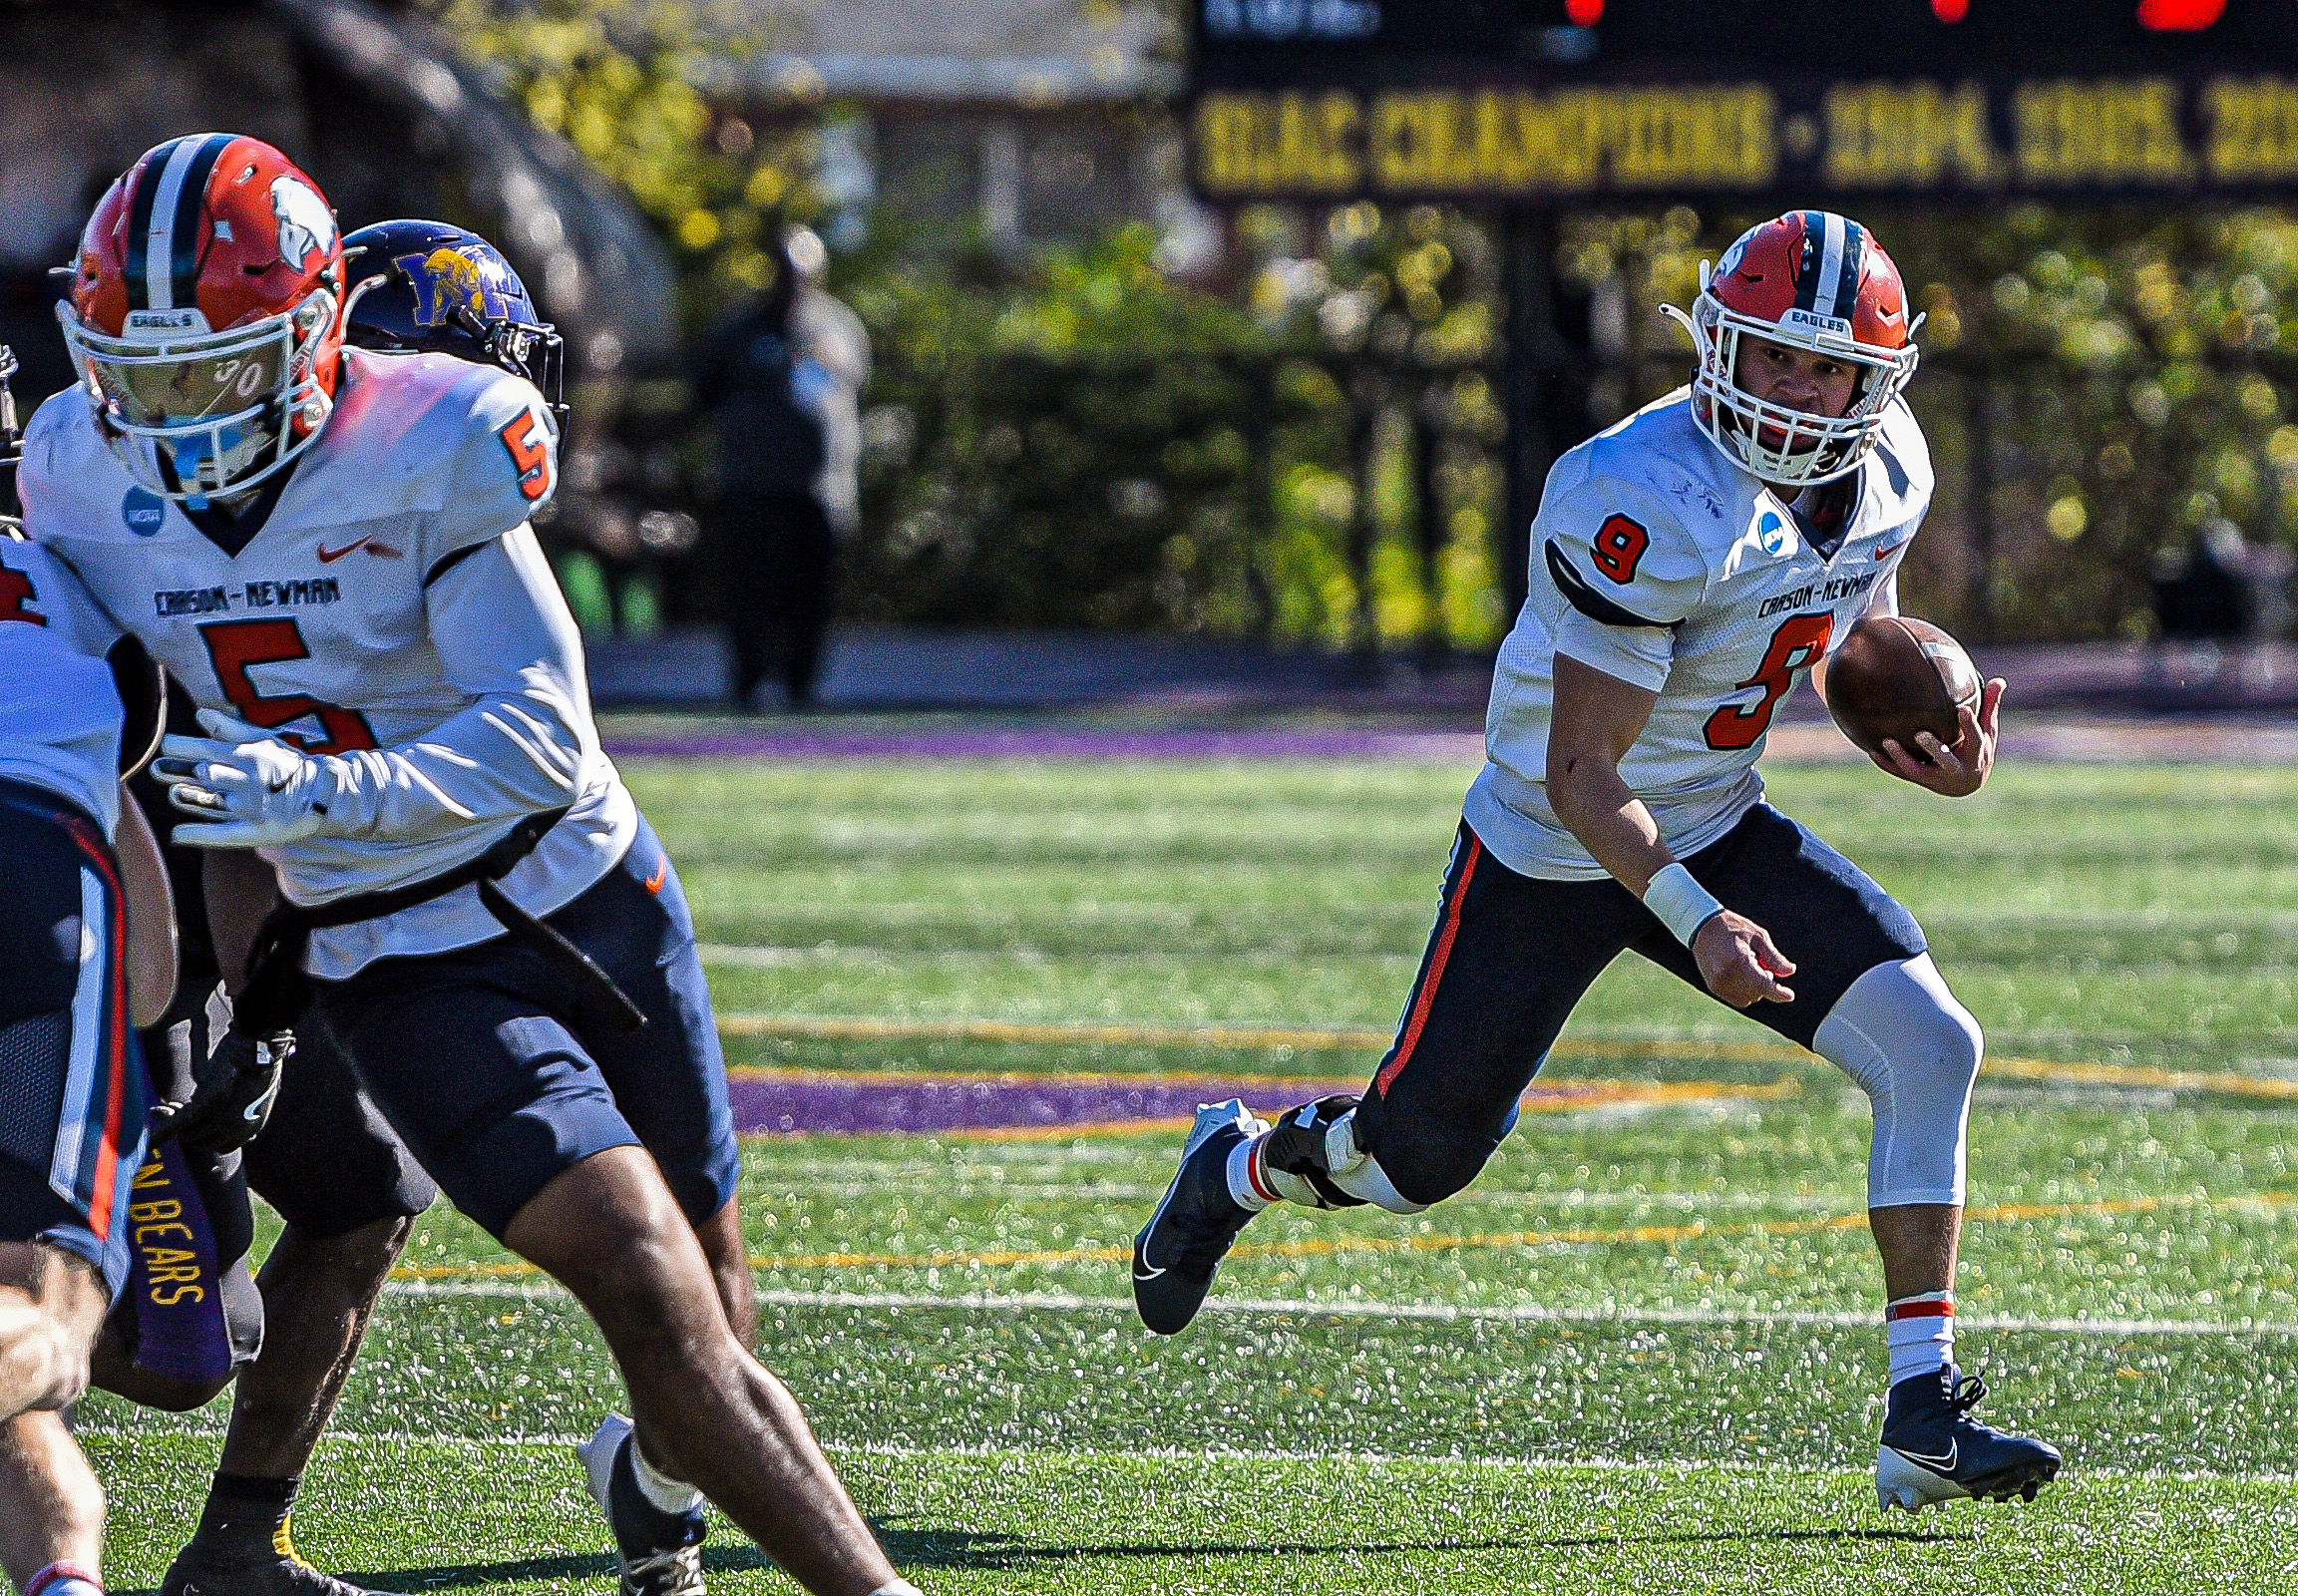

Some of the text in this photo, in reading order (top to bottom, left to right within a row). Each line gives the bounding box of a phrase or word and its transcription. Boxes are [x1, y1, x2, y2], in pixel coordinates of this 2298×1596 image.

[1791, 310, 1846, 333] EAGLES
[500, 409, 551, 501] 5
[1589, 512, 1651, 585] 9
[198, 616, 380, 756] 5
[1702, 608, 1836, 752] 9
[130, 1199, 204, 1305] BEARS
